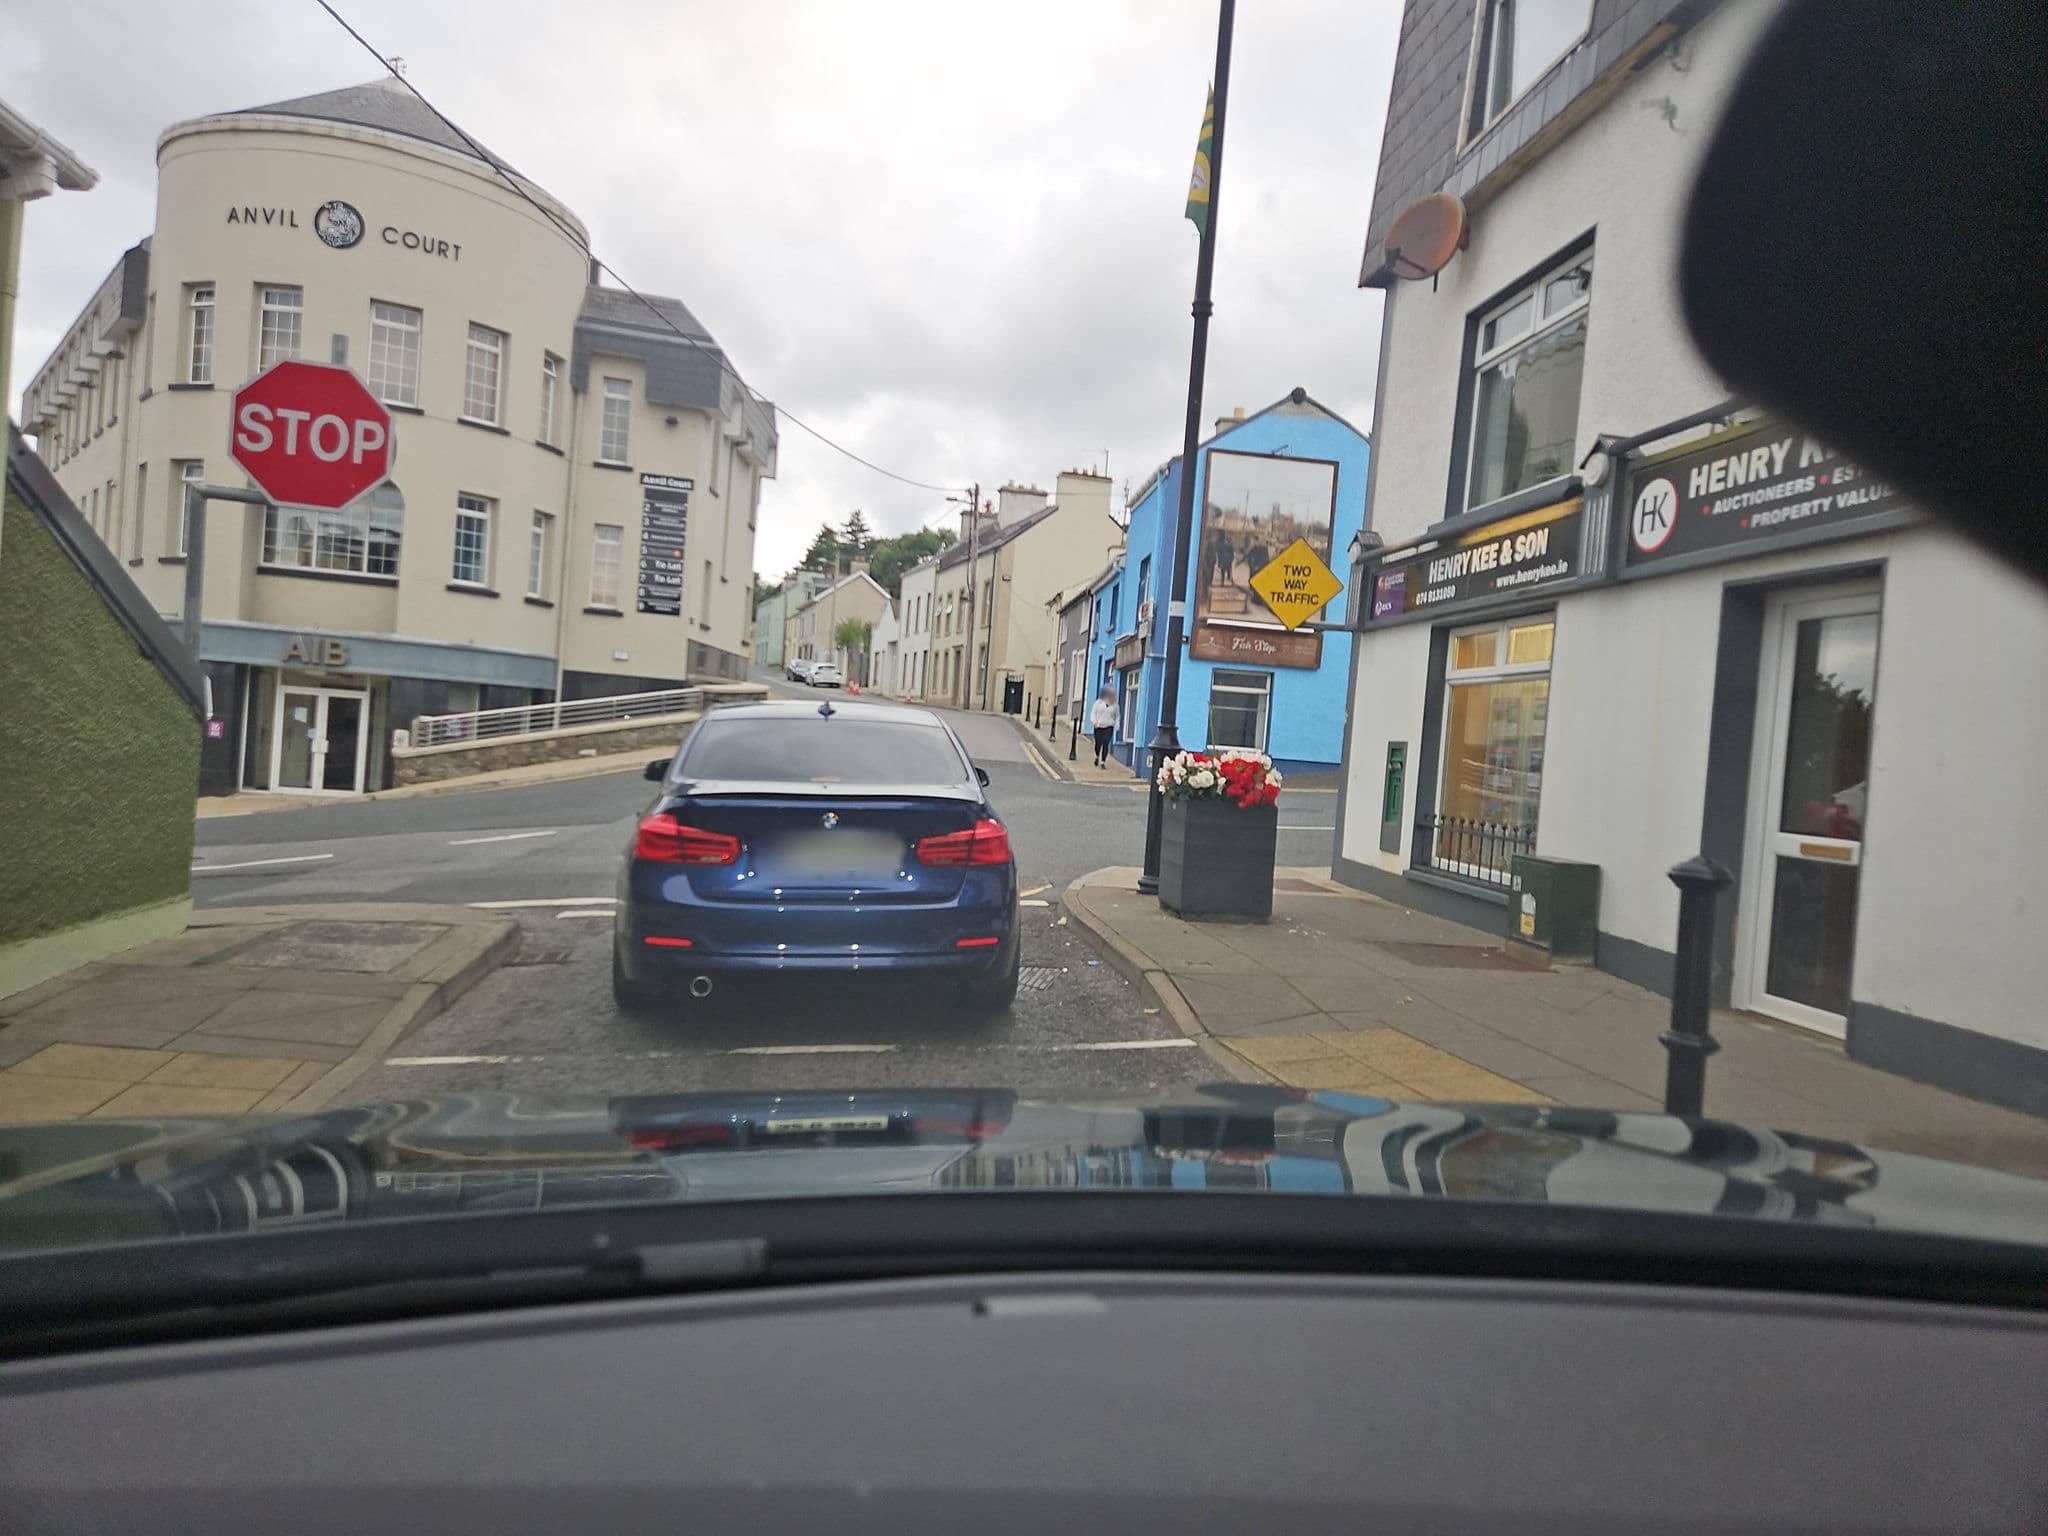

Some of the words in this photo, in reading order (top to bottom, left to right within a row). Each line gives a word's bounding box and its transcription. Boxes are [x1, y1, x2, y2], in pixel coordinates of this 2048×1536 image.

[227, 207, 299, 228] ANVIL
[382, 226, 463, 262] COURT
[237, 402, 386, 465] STOP
[1688, 438, 1793, 500] HENRY
[1639, 491, 1669, 536] HK
[1711, 475, 1817, 516] AUCTIONEERS
[1750, 496, 1834, 529] PROPERTY
[1283, 564, 1312, 578] TWO
[1428, 549, 1473, 585] HENRY
[1471, 543, 1498, 573] KEE
[1500, 538, 1514, 566] &
[1514, 527, 1550, 562] SON
[1496, 559, 1569, 588] www.henrykee.ie
[1269, 591, 1320, 606] TRAFFIC
[1283, 578, 1309, 590] WAY
[281, 634, 351, 667] AIB
